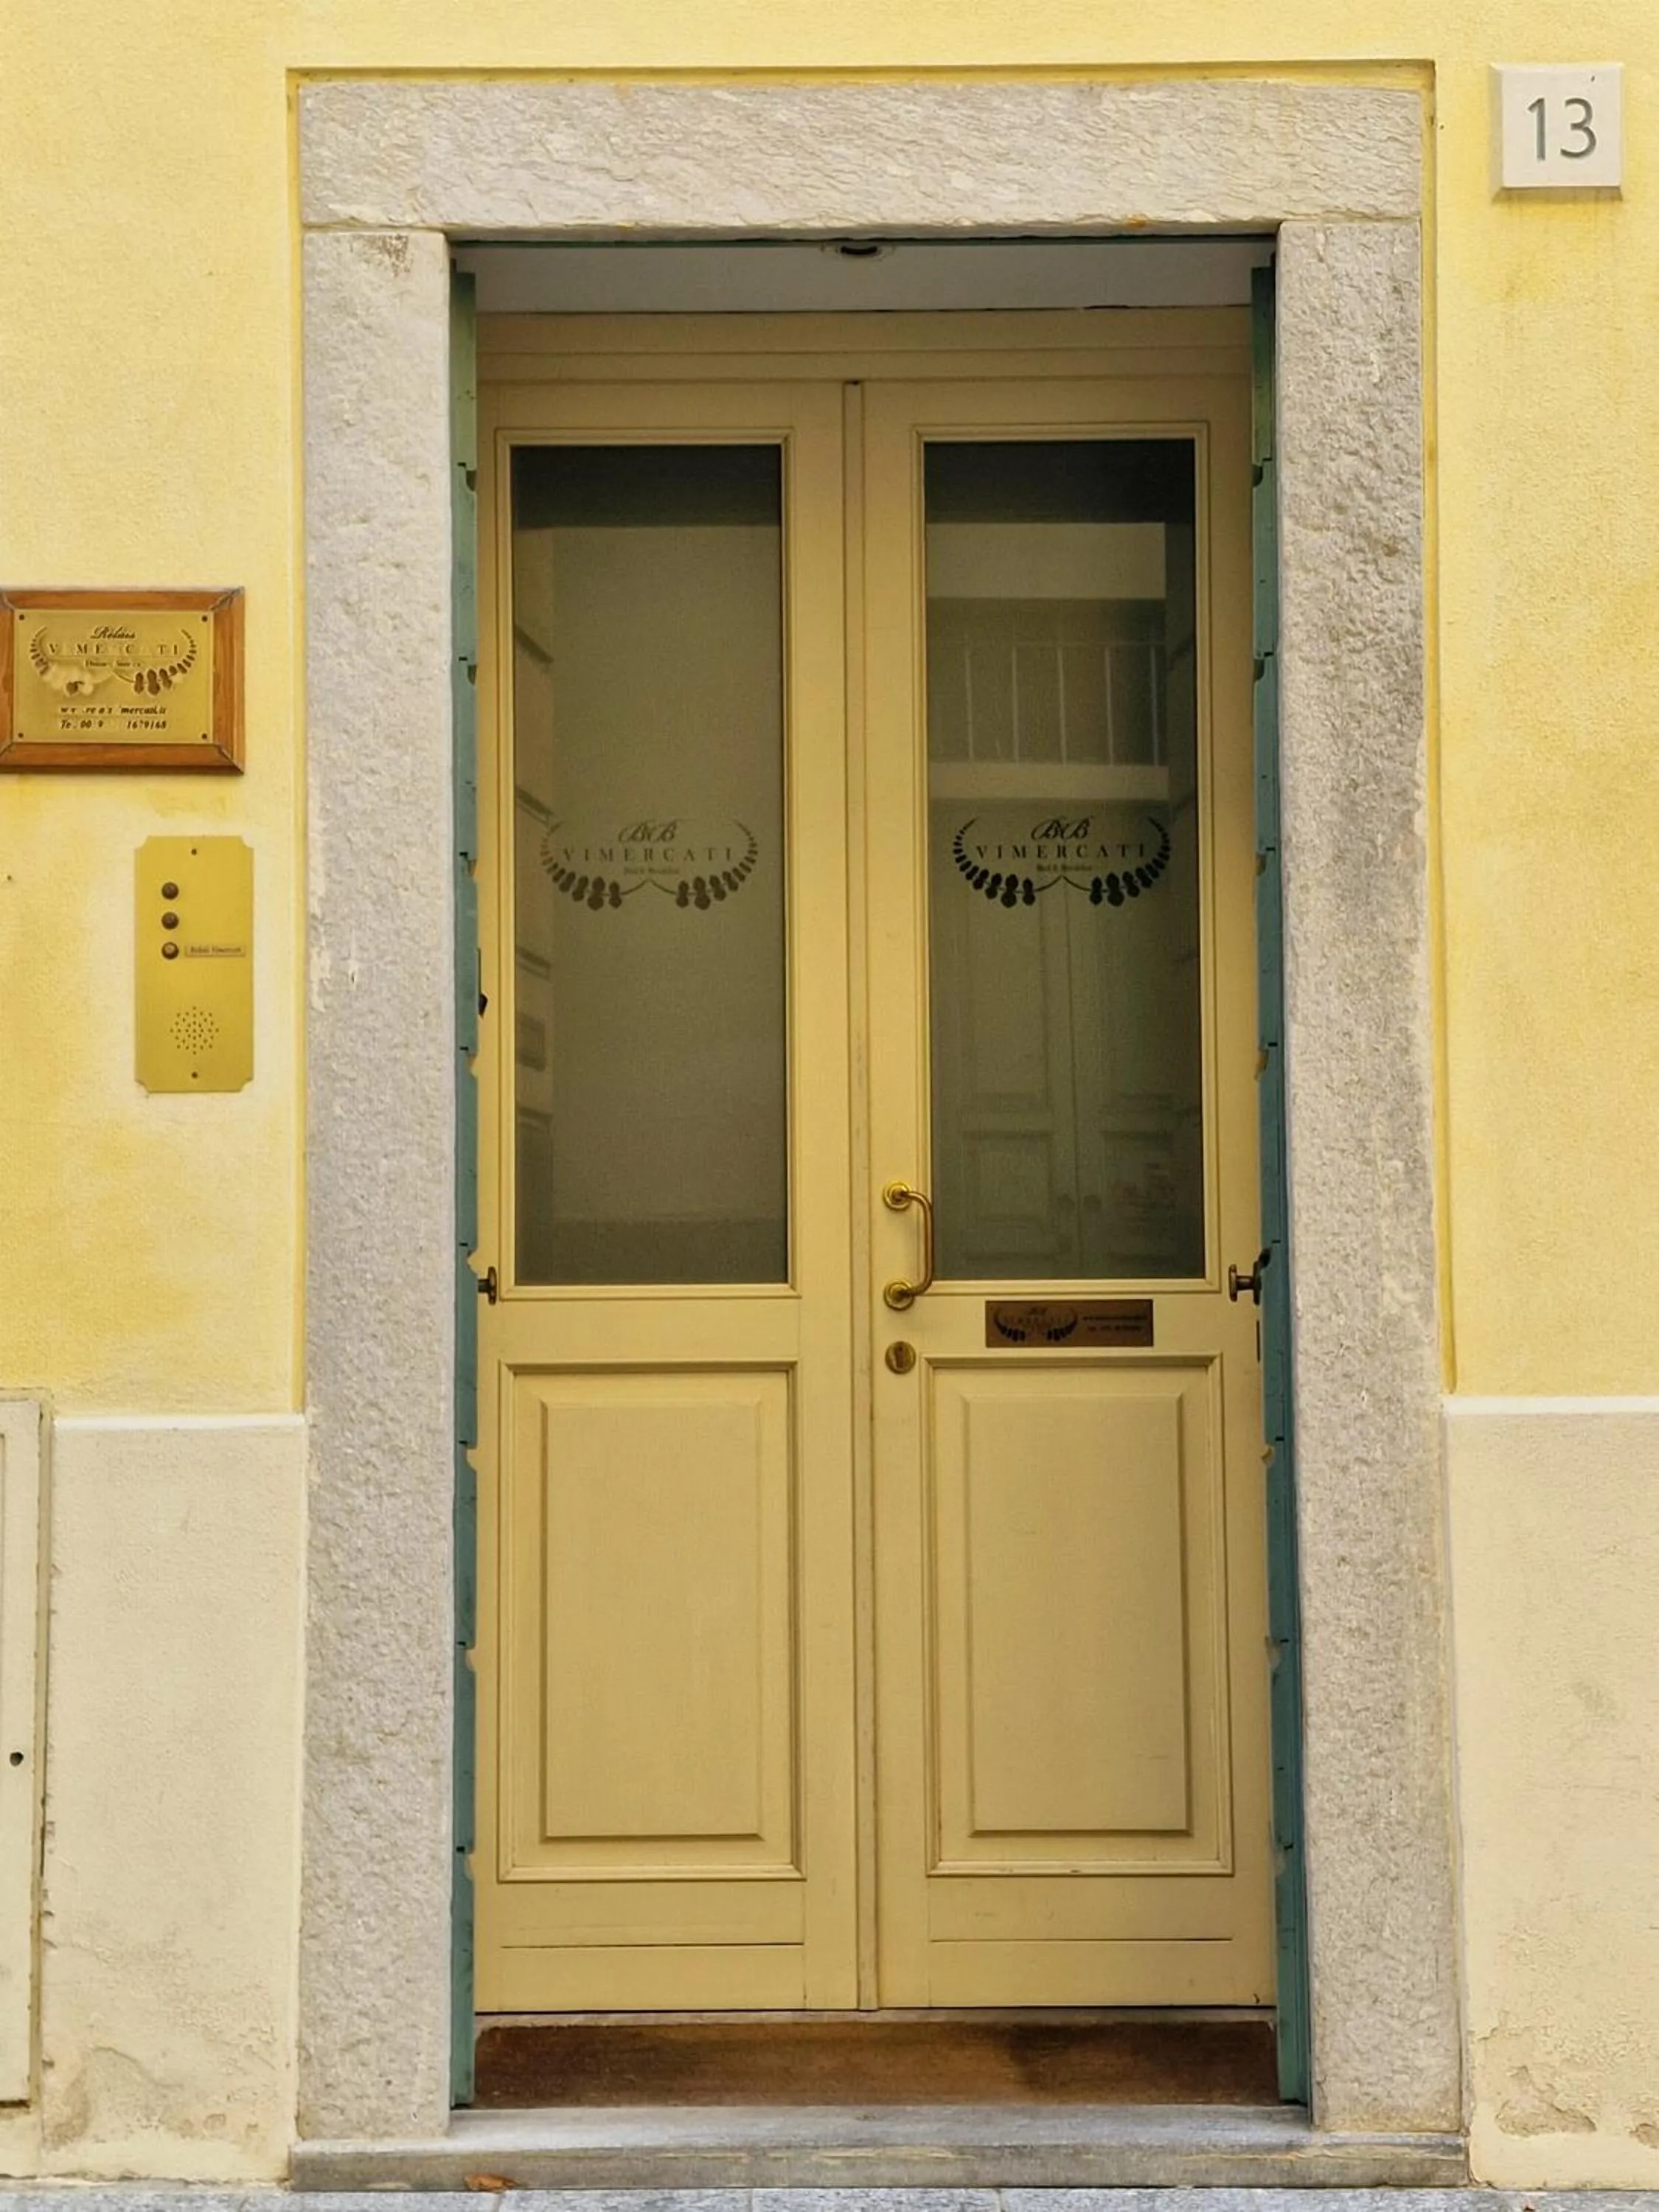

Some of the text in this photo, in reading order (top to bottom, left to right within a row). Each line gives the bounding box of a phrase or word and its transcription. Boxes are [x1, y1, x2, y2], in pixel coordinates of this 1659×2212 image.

[1527, 97, 1597, 161] 13
[89, 625, 136, 639] Relais
[563, 847, 731, 862] VIMERCATI
[975, 844, 1145, 860] VIMERCATI
